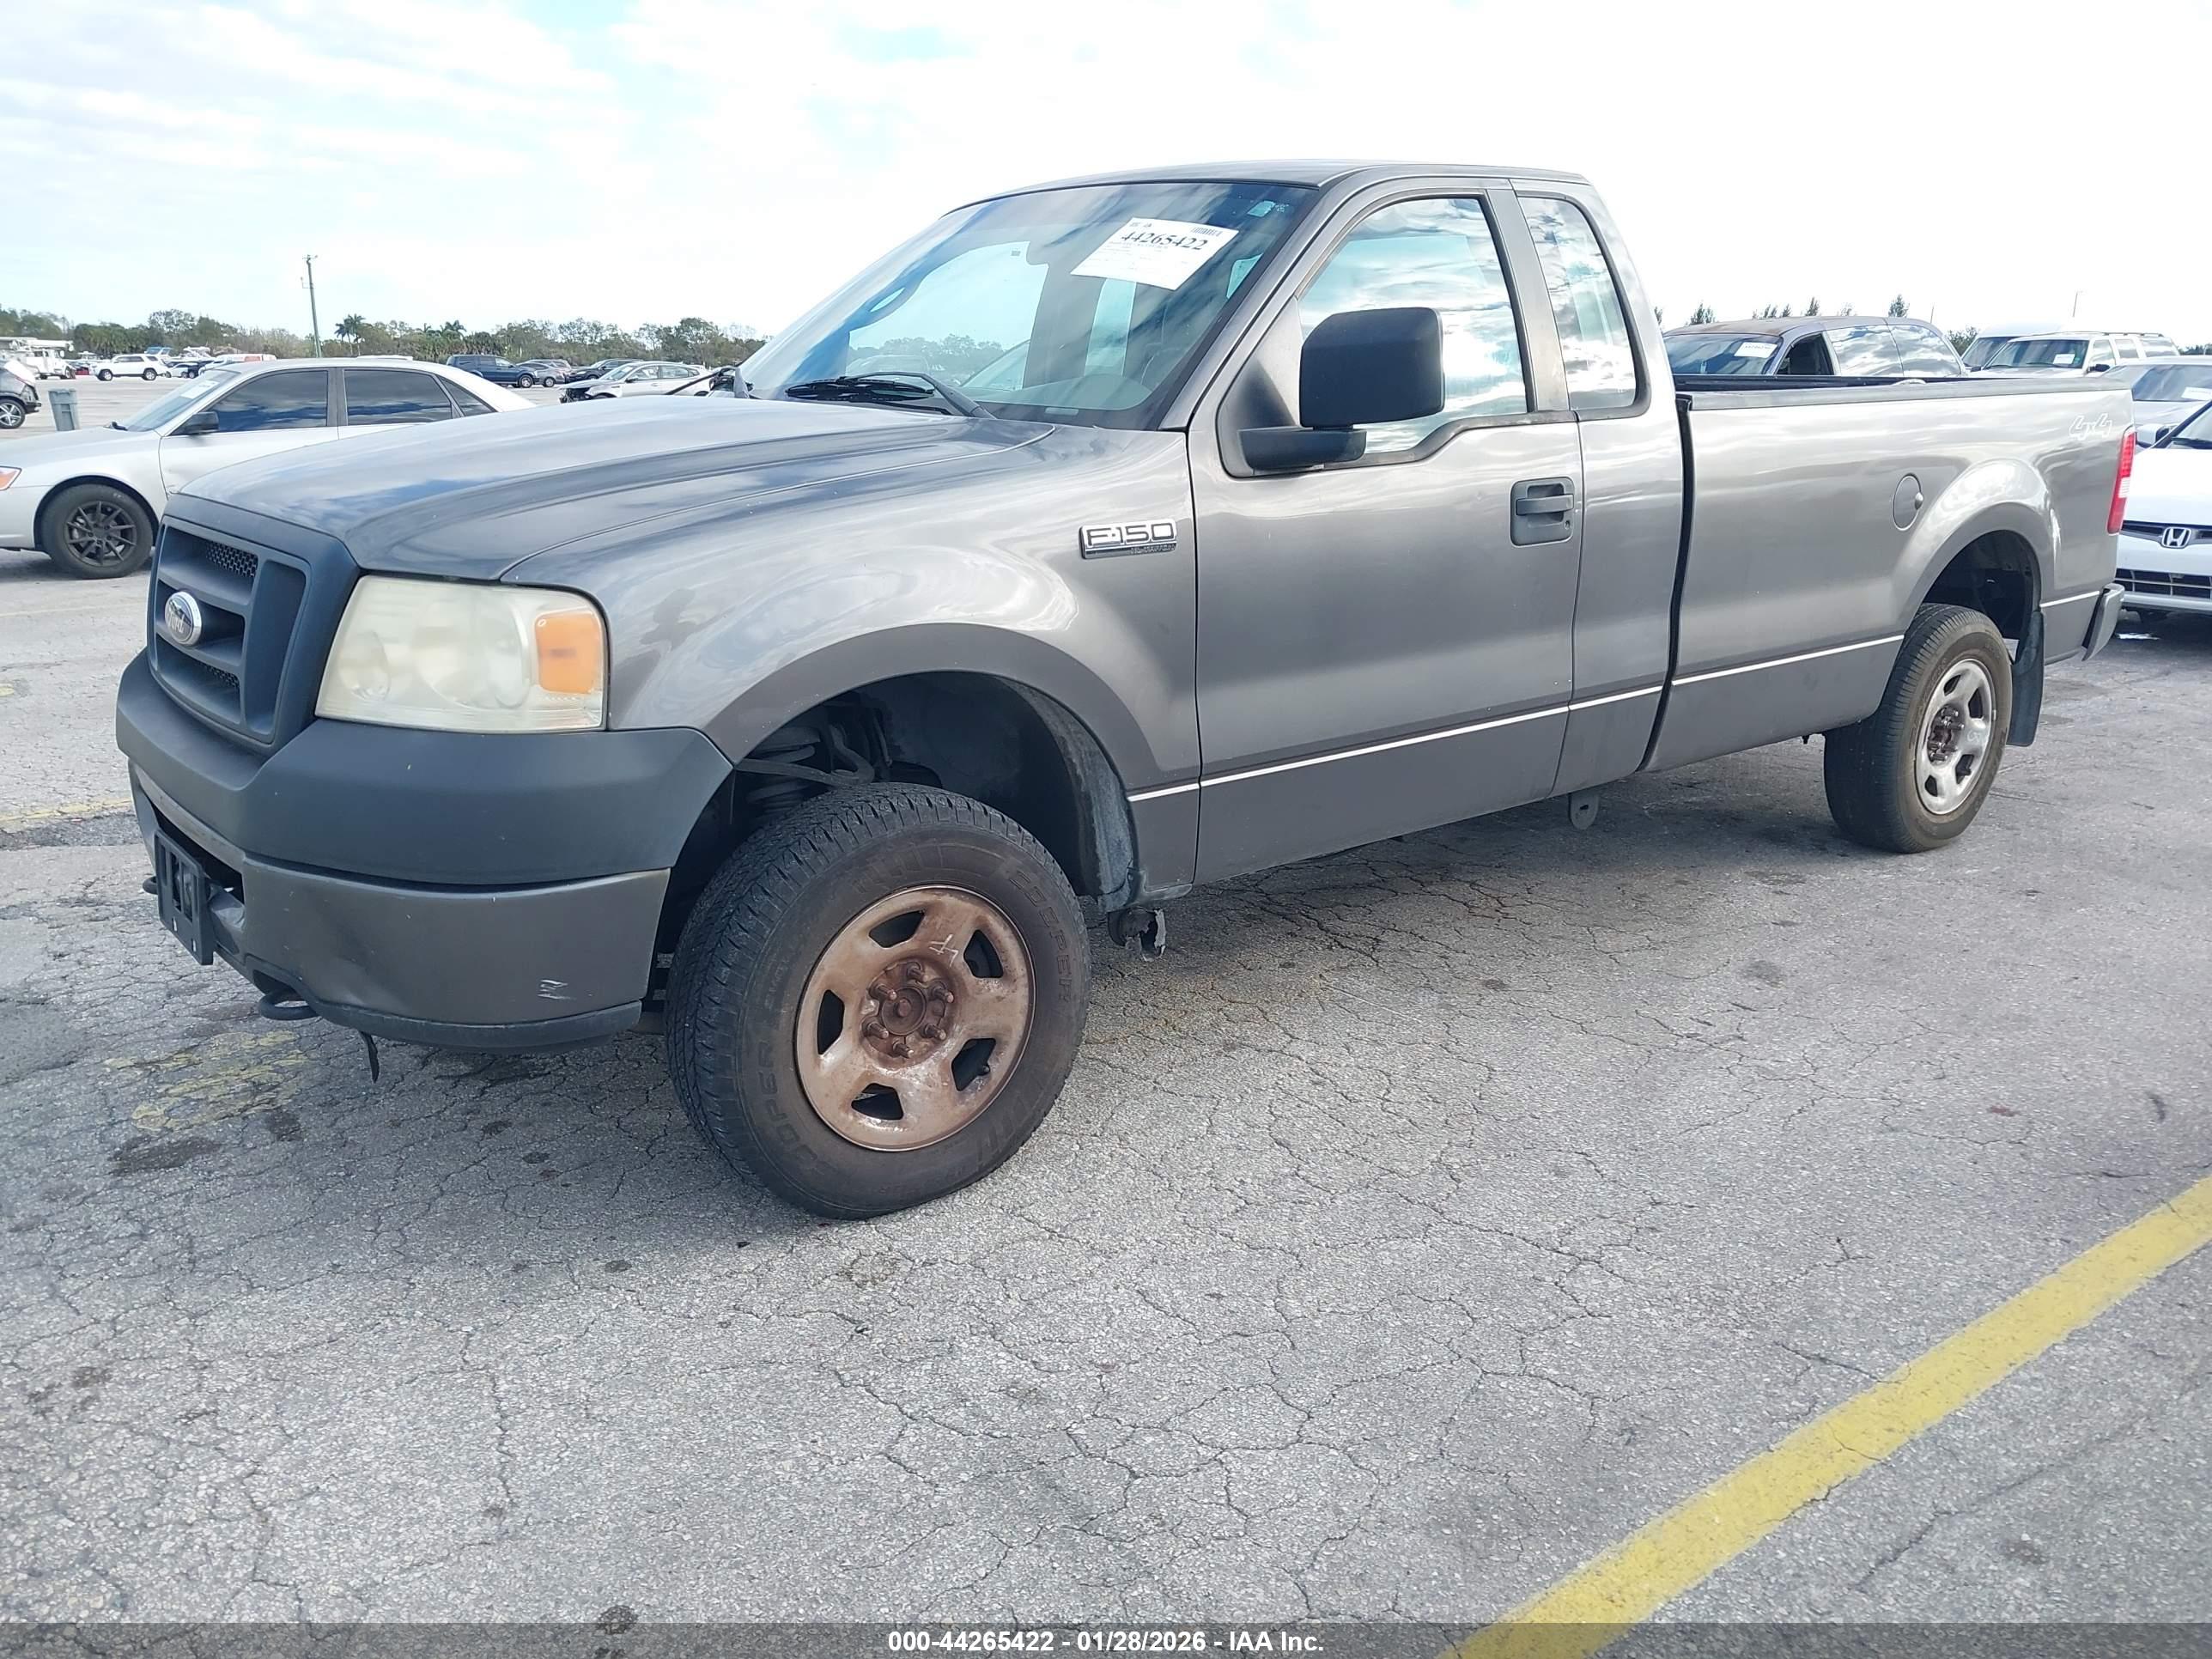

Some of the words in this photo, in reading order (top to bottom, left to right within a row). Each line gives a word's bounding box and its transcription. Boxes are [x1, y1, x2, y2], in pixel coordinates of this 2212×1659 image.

[1121, 230, 1208, 251] 44265422
[2069, 412, 2113, 441] 4x4
[757, 1041, 835, 1176] OOPER
